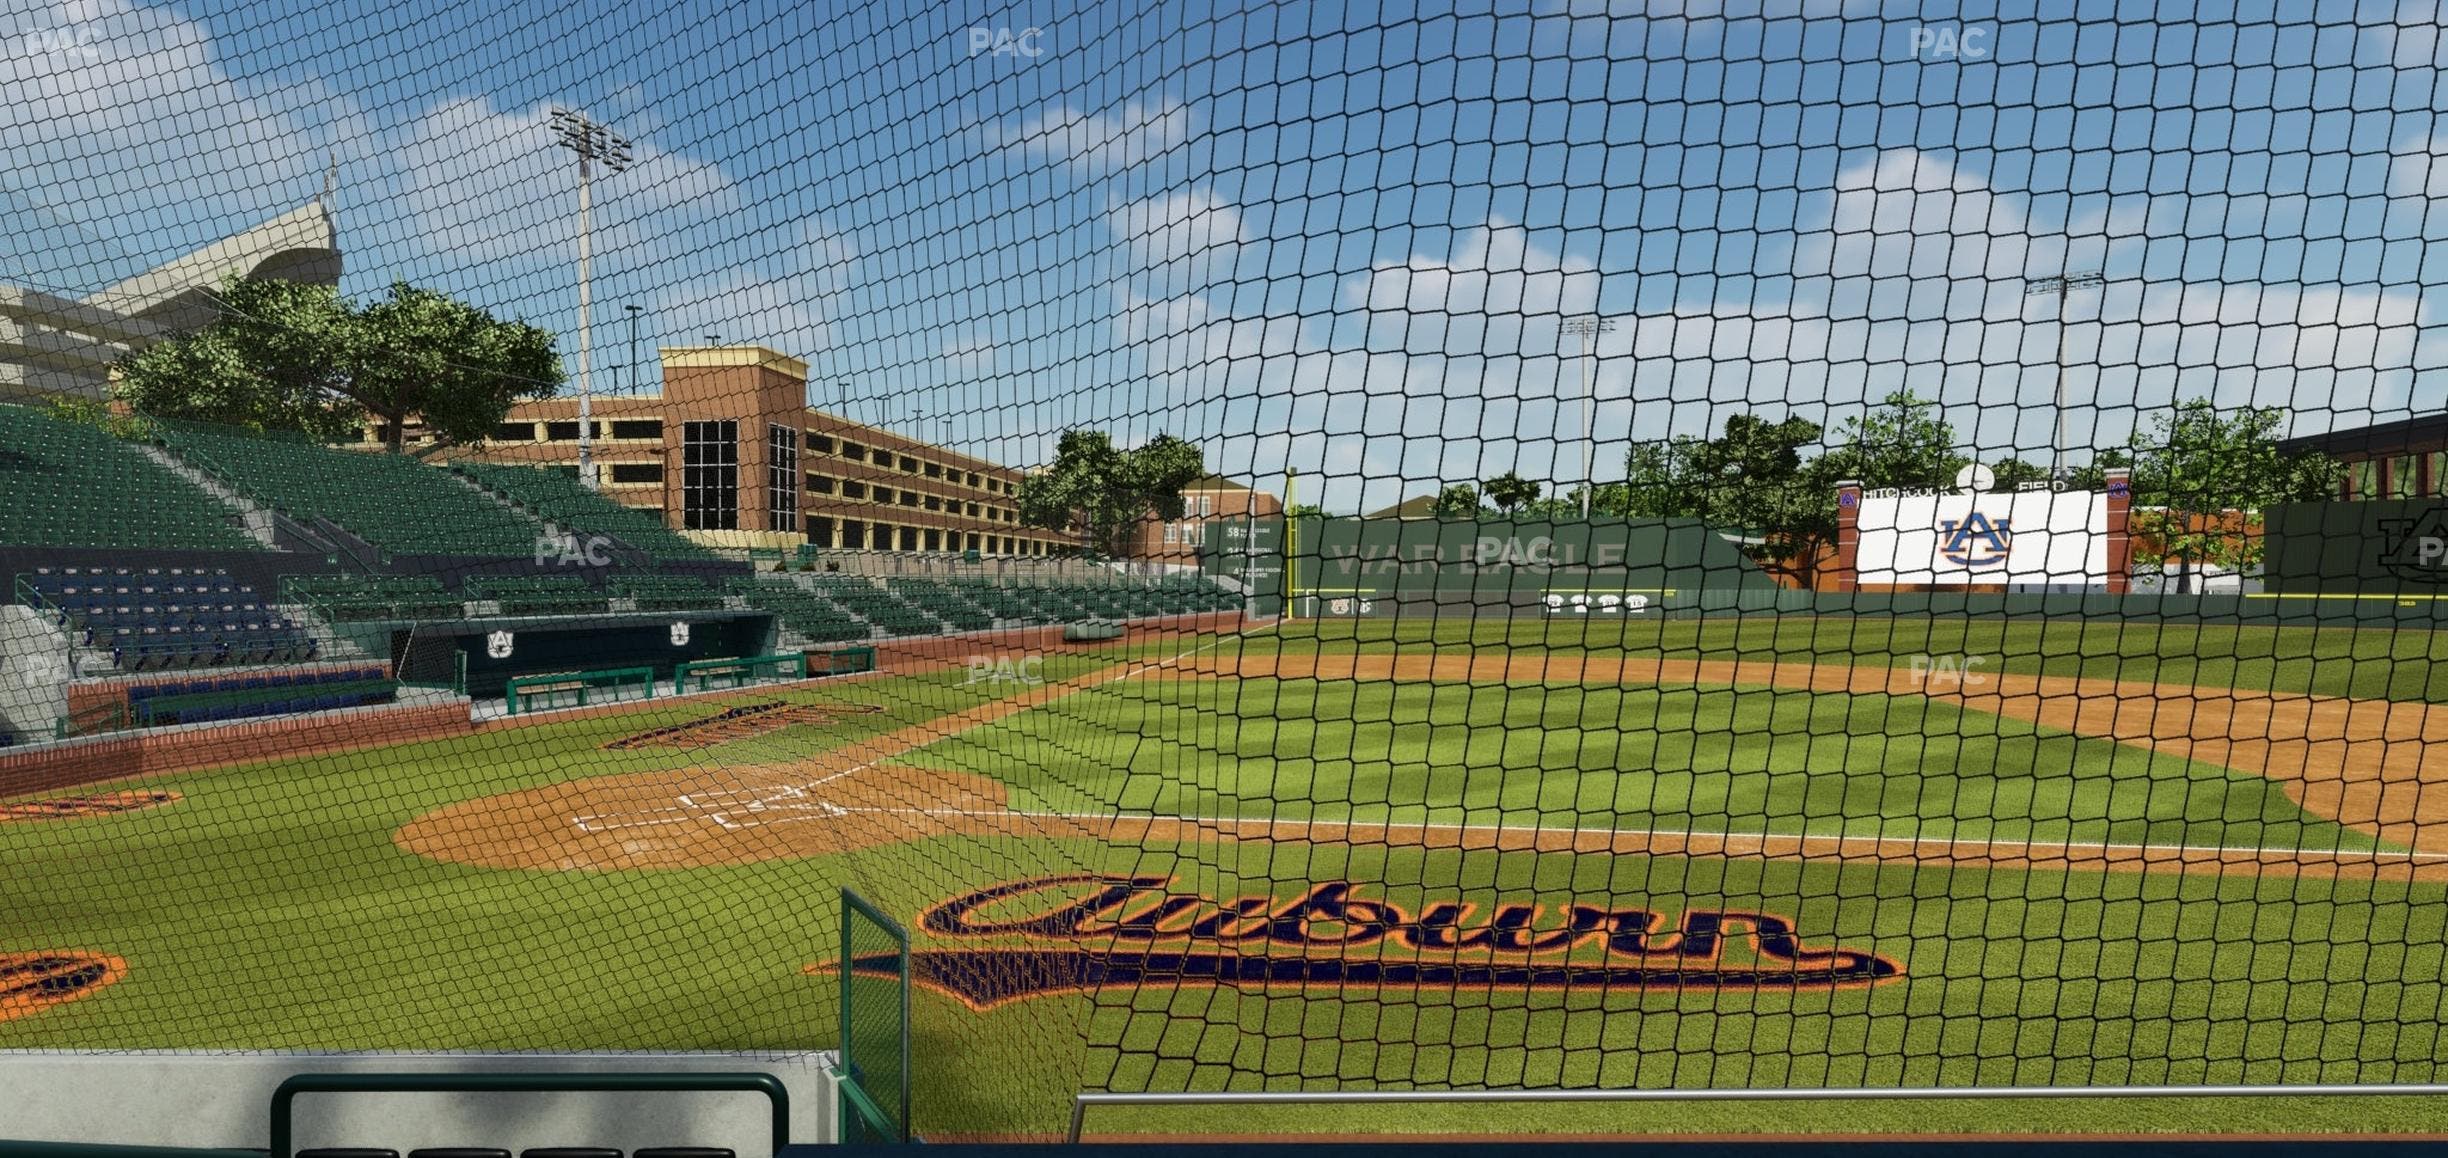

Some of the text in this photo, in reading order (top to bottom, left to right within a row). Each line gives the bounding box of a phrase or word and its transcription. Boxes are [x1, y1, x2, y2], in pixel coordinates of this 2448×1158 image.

[1331, 543, 1628, 576] WAR EAGLE
[916, 871, 1905, 979] Auburn
